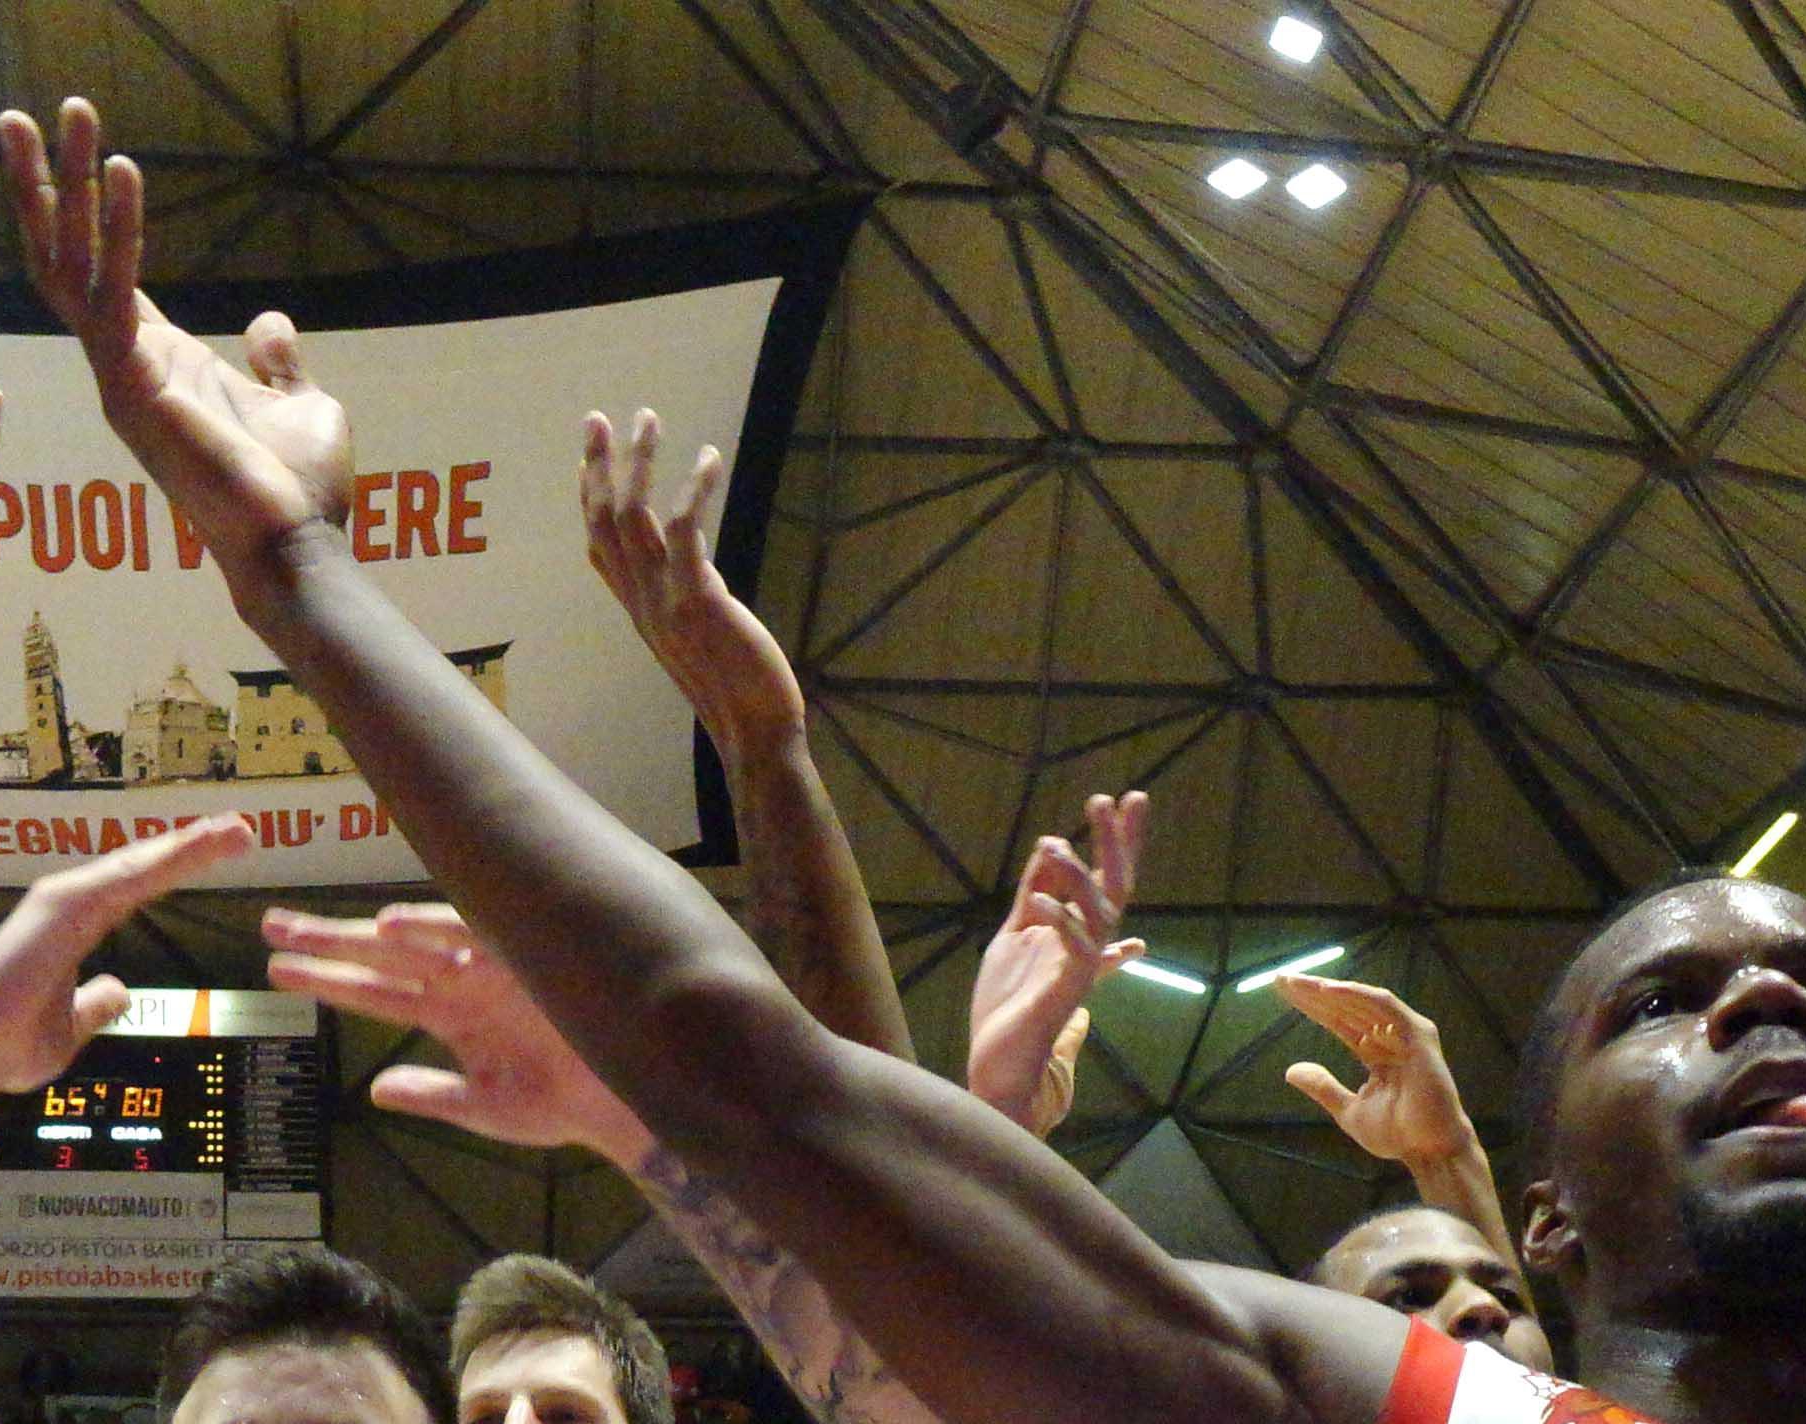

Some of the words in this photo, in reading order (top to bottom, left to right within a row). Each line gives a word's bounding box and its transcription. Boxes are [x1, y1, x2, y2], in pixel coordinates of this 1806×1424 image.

[245, 807, 325, 849] IU'
[121, 1086, 164, 1118] 80
[61, 1239, 137, 1258] PISTOIA
[144, 1240, 216, 1260] BASKET
